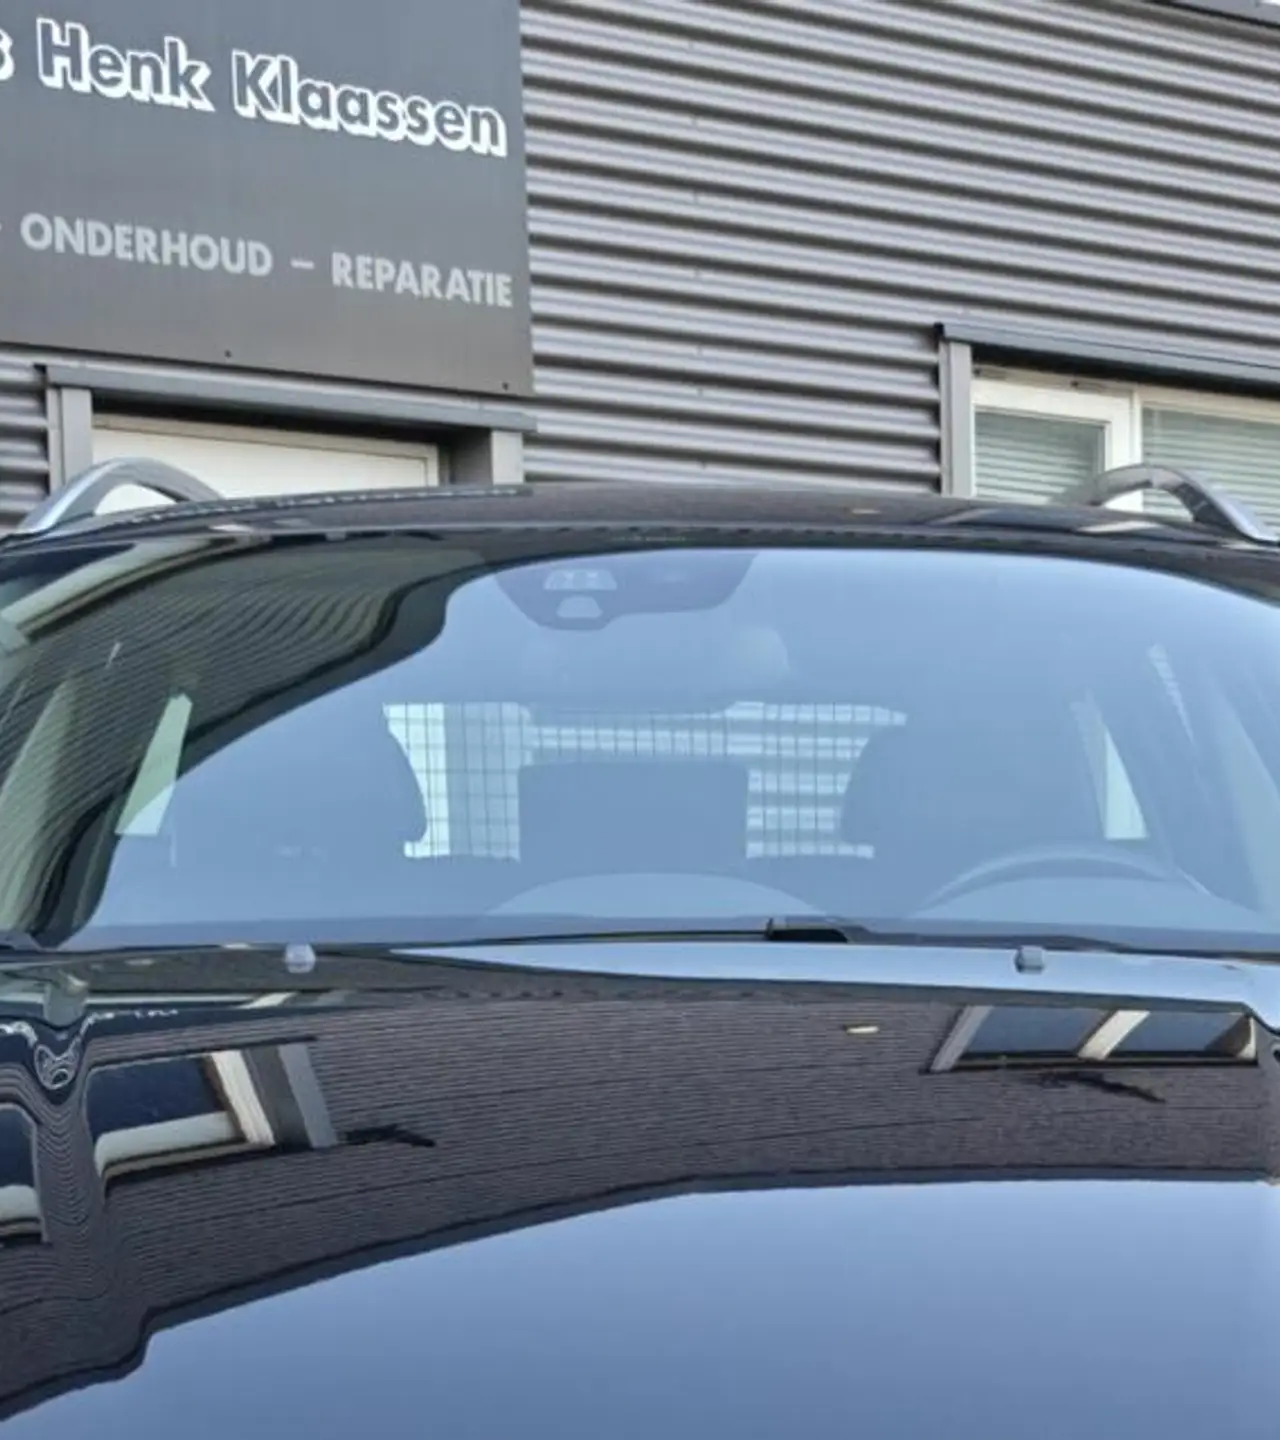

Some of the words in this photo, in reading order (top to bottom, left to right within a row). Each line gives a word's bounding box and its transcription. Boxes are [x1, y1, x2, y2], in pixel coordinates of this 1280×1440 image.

[36, 17, 215, 112] Henk
[231, 49, 508, 157] Klaassen
[20, 212, 273, 277] ONDERHOUD
[331, 251, 514, 308] REPARATIE
